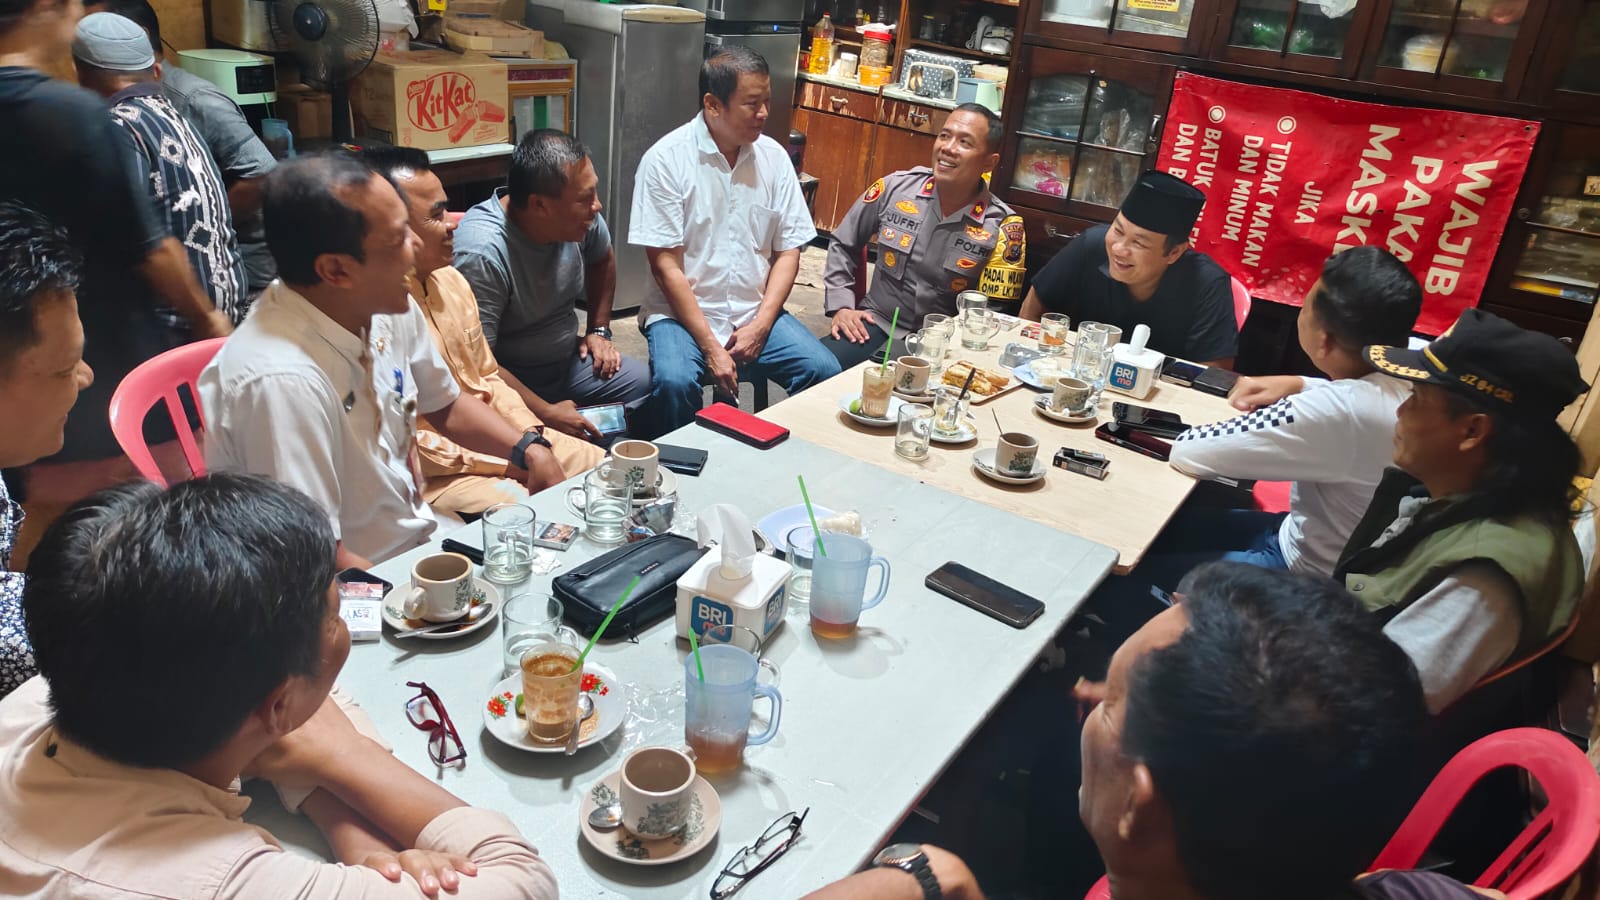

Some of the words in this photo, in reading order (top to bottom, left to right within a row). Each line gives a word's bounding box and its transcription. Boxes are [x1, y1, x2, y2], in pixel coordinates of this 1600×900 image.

[416, 75, 473, 129] KitKat
[1172, 123, 1198, 162] DAN
[1192, 127, 1222, 188] BATUK
[1237, 134, 1264, 174] DAN
[1259, 141, 1292, 197] TIDAK
[887, 213, 918, 231] JUFRI
[1221, 178, 1253, 241] MINUM
[1294, 181, 1323, 223] JIKA
[1241, 201, 1274, 267] MAKAN
[1425, 160, 1499, 295] WAJIB
[982, 283, 999, 293] OMP
[984, 267, 1004, 283] PADAL
[1115, 367, 1134, 380] BRI
[698, 602, 727, 625] BRI
[768, 591, 783, 618] BRI
